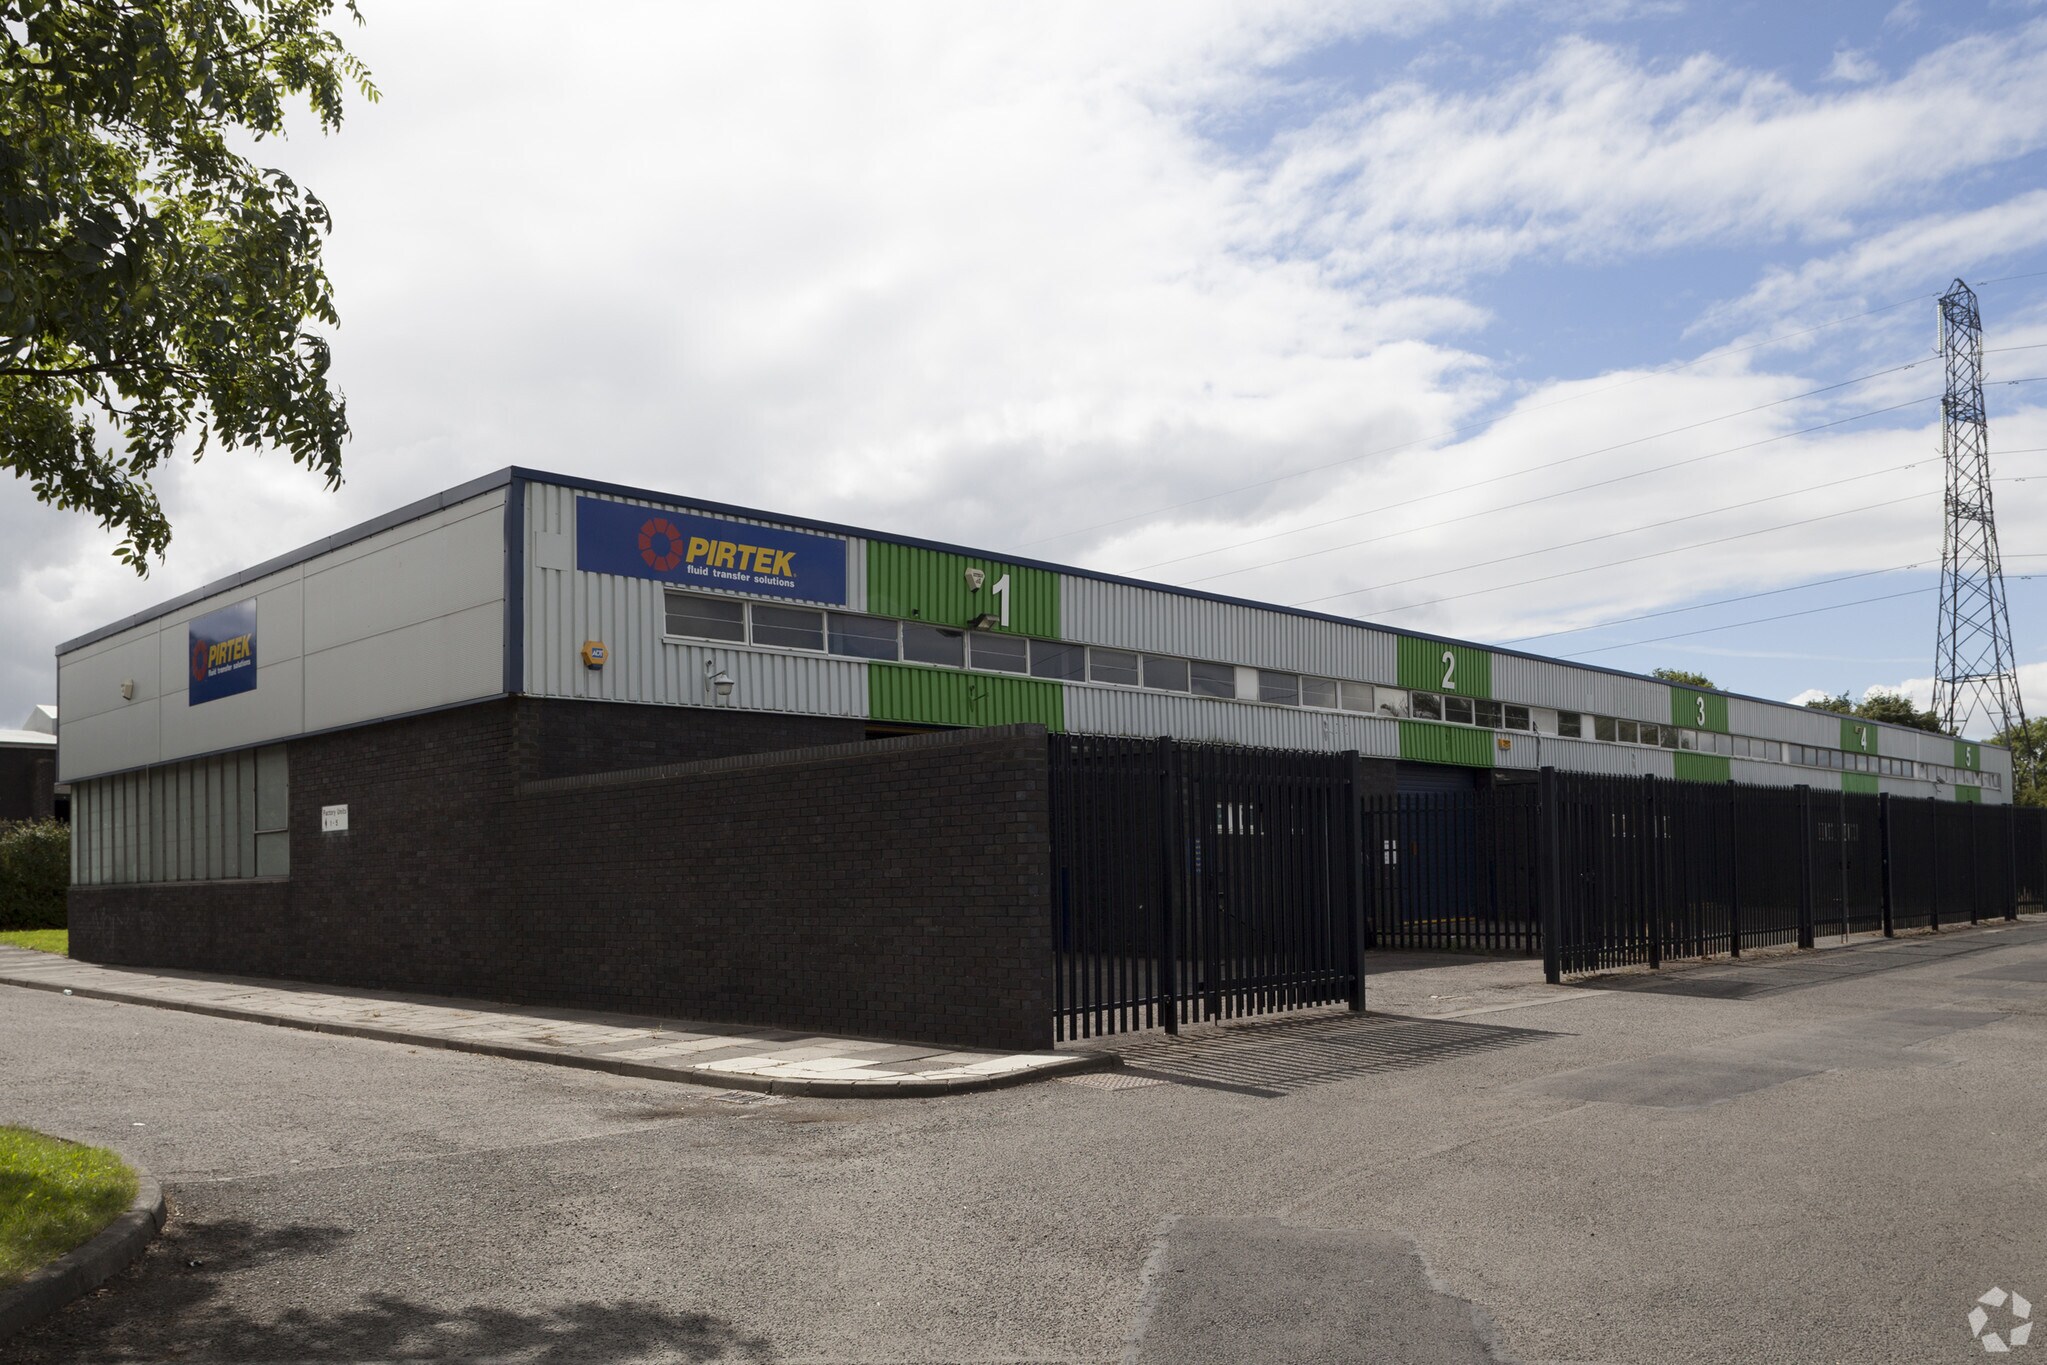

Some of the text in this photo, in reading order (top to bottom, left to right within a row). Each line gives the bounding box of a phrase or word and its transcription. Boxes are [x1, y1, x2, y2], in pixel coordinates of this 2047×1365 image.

[685, 536, 797, 578] PIRTEK
[687, 565, 795, 588] fluid transfer solutions
[992, 573, 1010, 627] 1
[208, 633, 251, 668] PIRTEK
[1442, 651, 1455, 689] 2
[1696, 697, 1705, 726] 3
[1861, 727, 1868, 751] 4
[1965, 747, 1971, 768] 5
